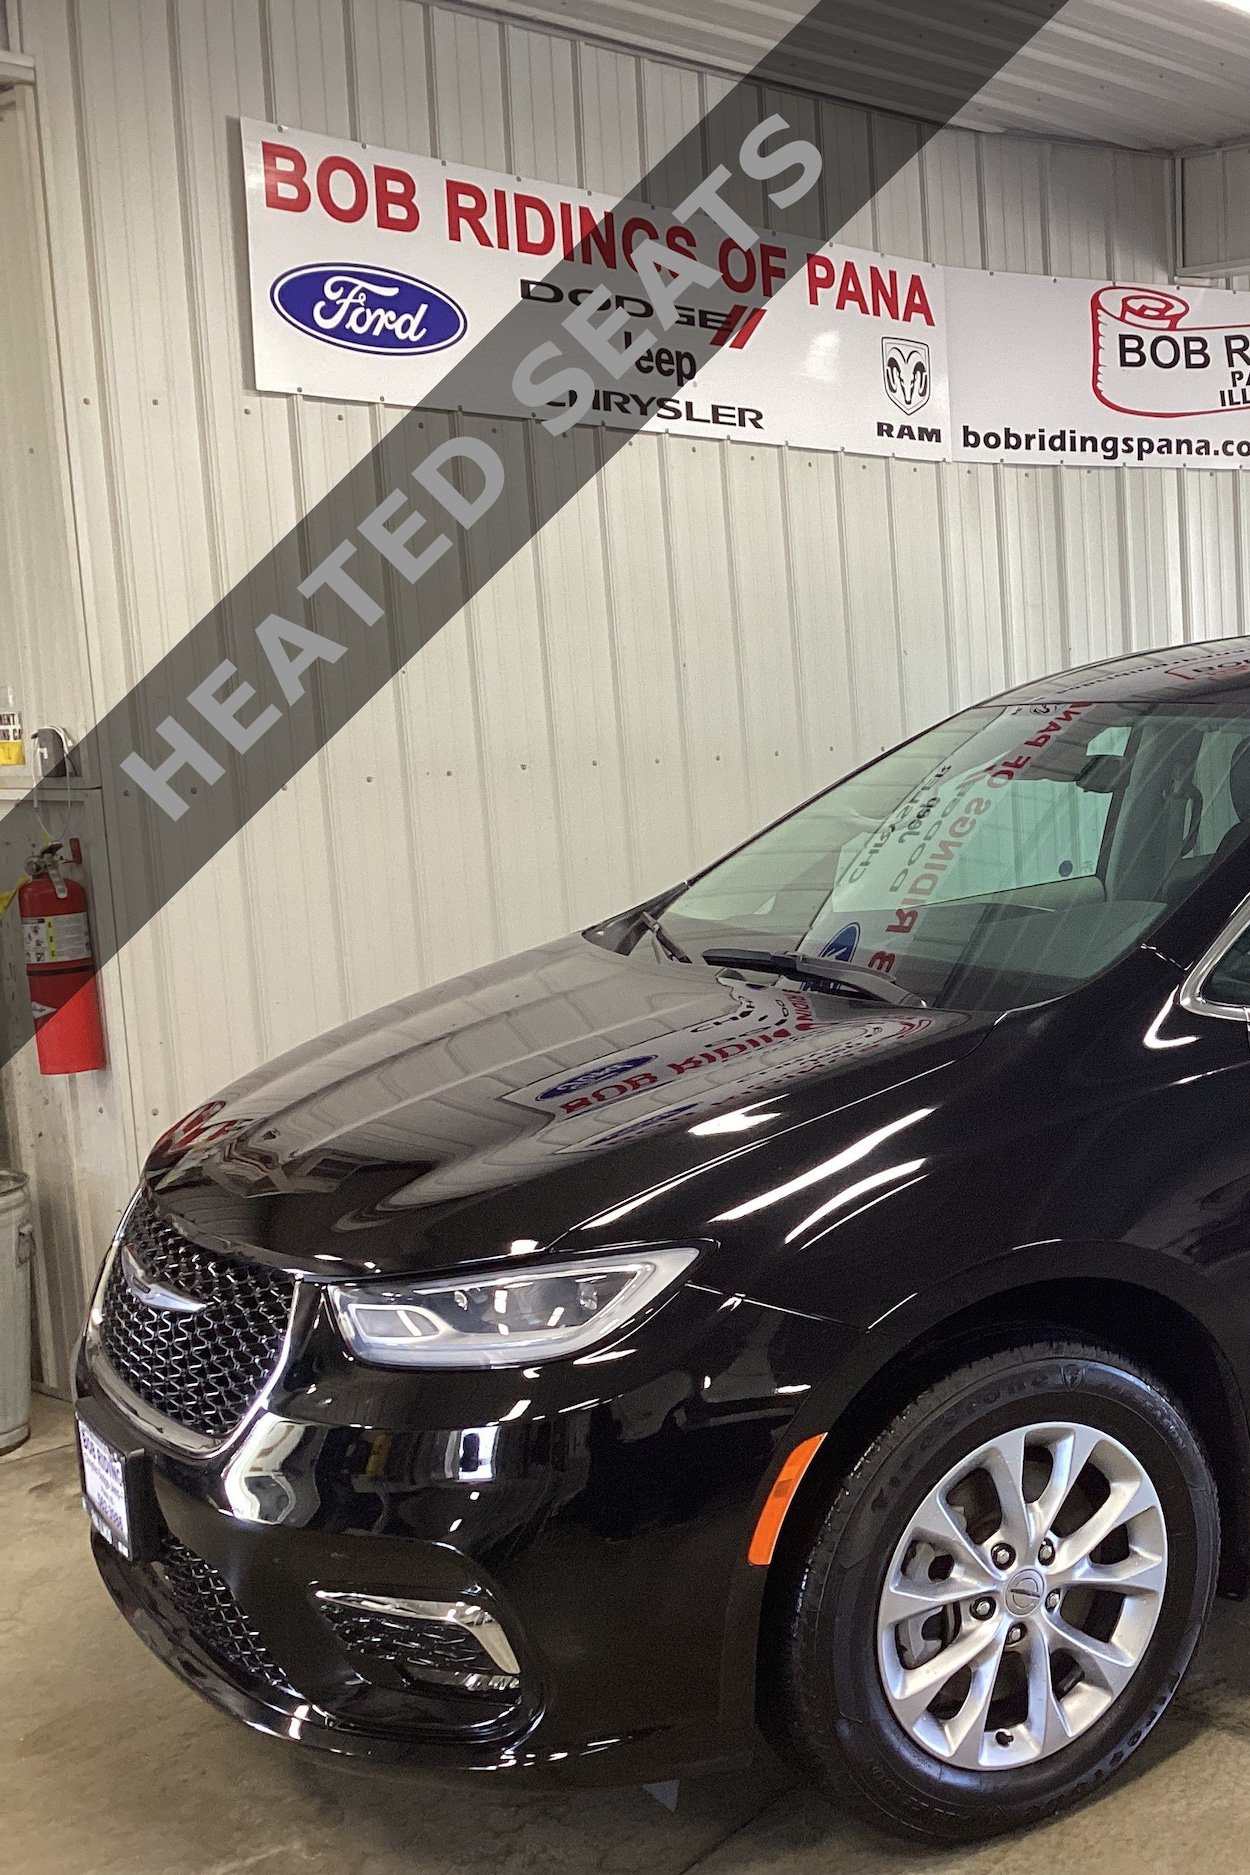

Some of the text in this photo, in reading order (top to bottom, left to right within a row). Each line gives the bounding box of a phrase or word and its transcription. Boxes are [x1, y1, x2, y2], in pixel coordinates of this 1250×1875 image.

[261, 140, 421, 233] BOB
[718, 237, 788, 298] OF
[806, 253, 937, 328] PANA
[313, 274, 428, 344] Ford
[1116, 332, 1211, 370] BOB
[876, 421, 943, 444] RAM
